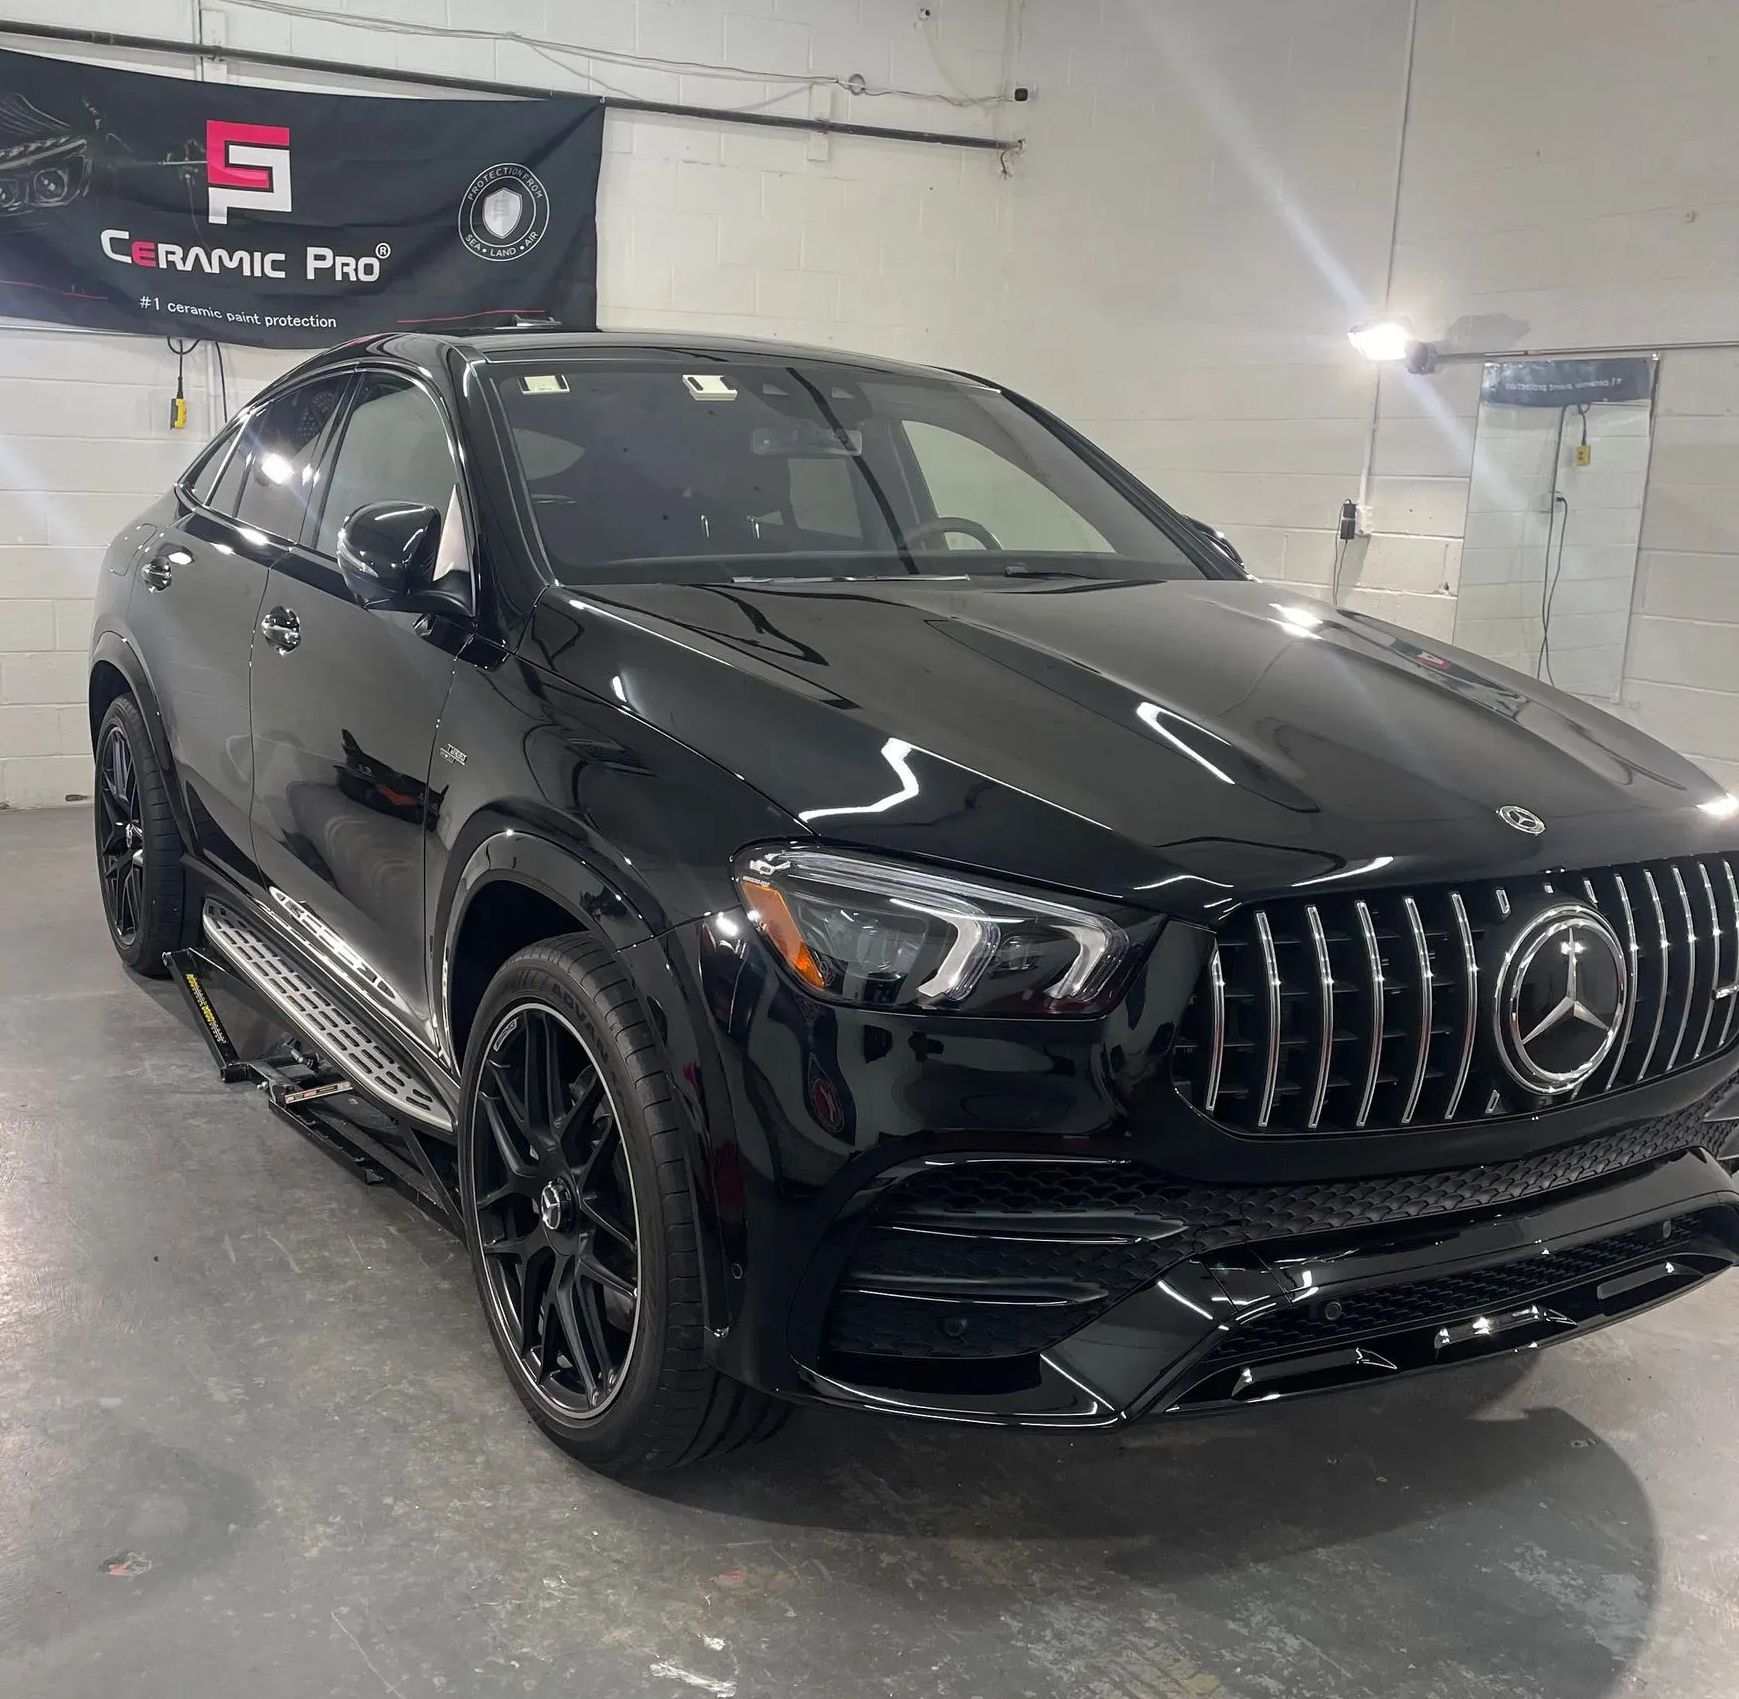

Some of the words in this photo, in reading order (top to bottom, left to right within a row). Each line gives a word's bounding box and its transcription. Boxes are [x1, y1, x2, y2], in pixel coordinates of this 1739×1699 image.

[468, 167, 522, 201] PROTECTION
[522, 173, 543, 199] FROM
[100, 229, 286, 279] CERAMIC
[465, 234, 481, 251] SEA
[490, 247, 516, 257] LAND
[523, 231, 539, 247] AIR
[139, 295, 160, 311] #1
[167, 302, 223, 319] ceramic
[226, 311, 262, 325] paint
[264, 314, 337, 328] protection
